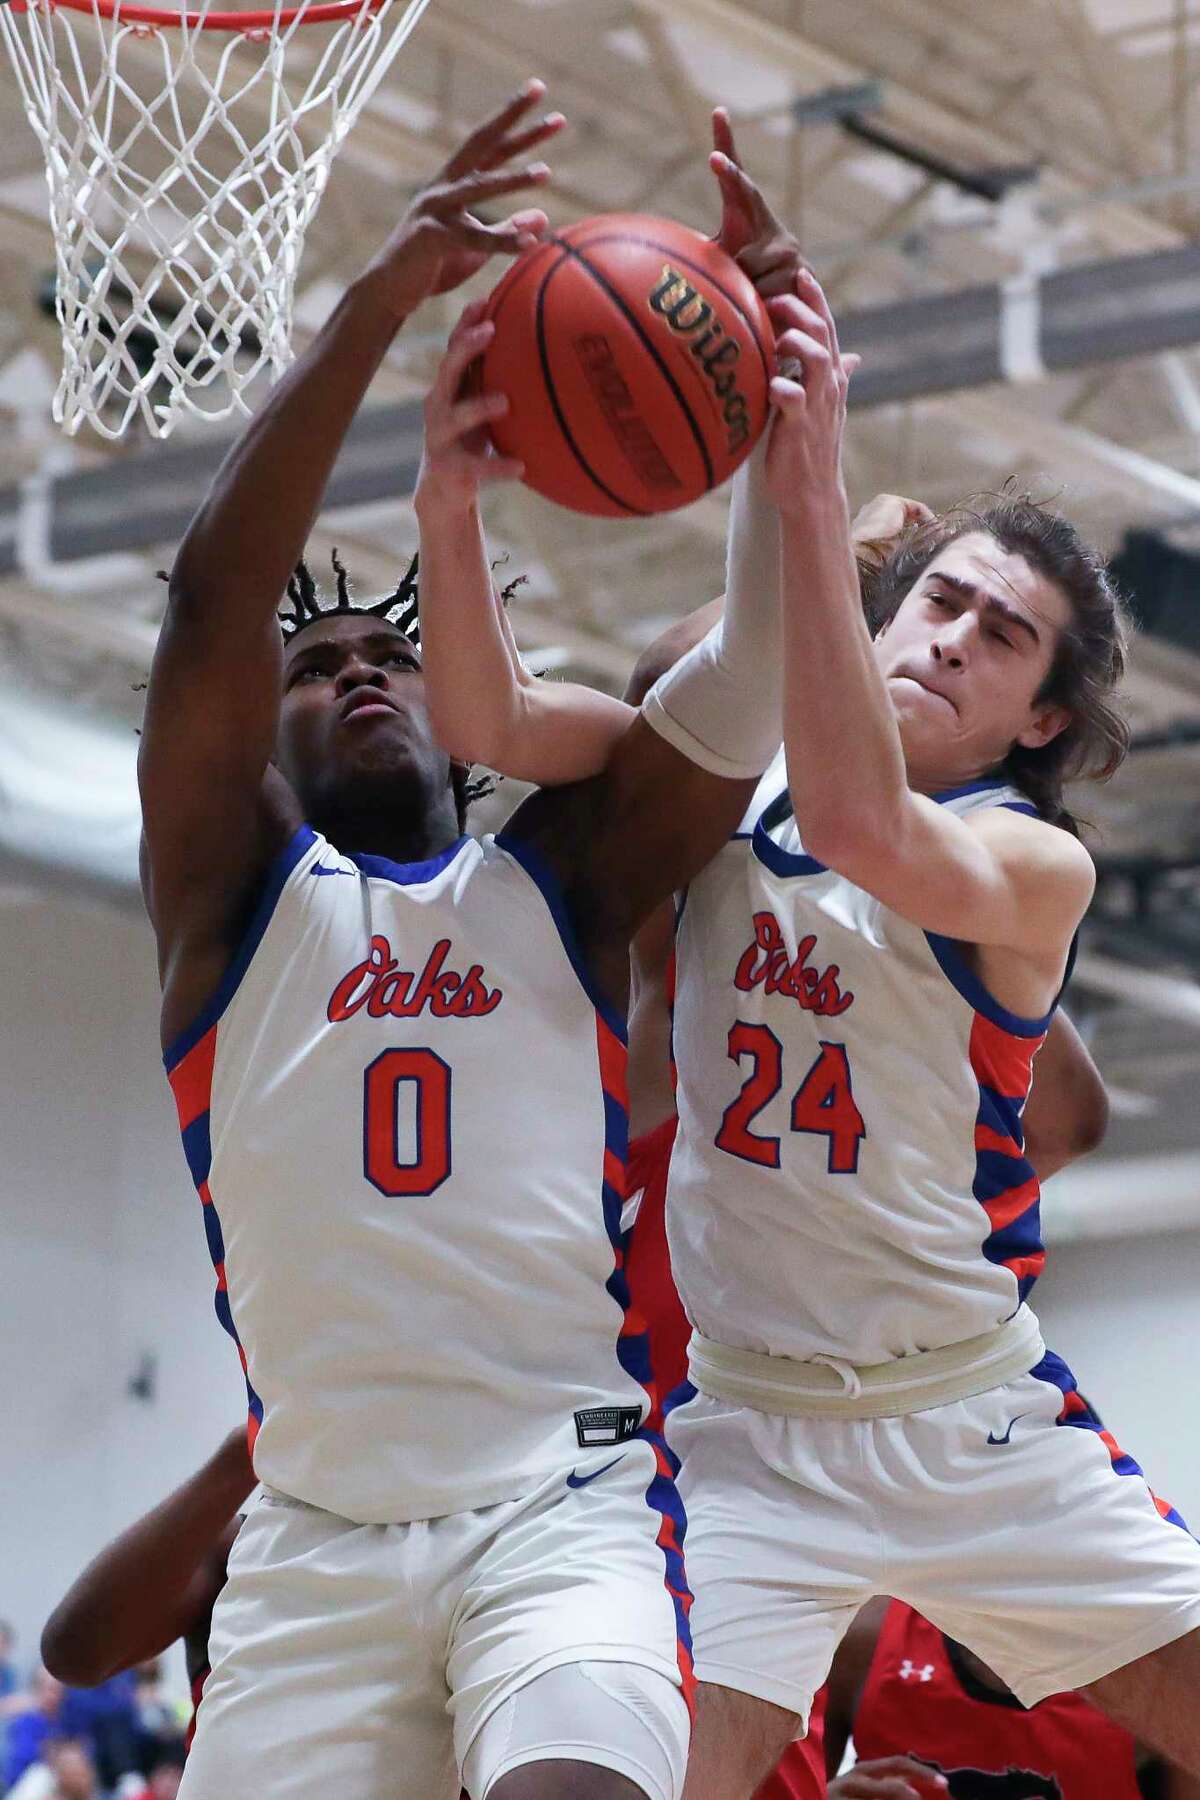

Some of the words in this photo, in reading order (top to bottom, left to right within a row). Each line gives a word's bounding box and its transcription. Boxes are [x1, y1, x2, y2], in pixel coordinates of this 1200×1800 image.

[648, 263, 750, 455] Wilson
[327, 934, 503, 1023] Oaks
[734, 911, 855, 1016] Oaks
[363, 1047, 452, 1197] 0
[714, 1019, 866, 1174] 24
[624, 1418, 634, 1433] M
